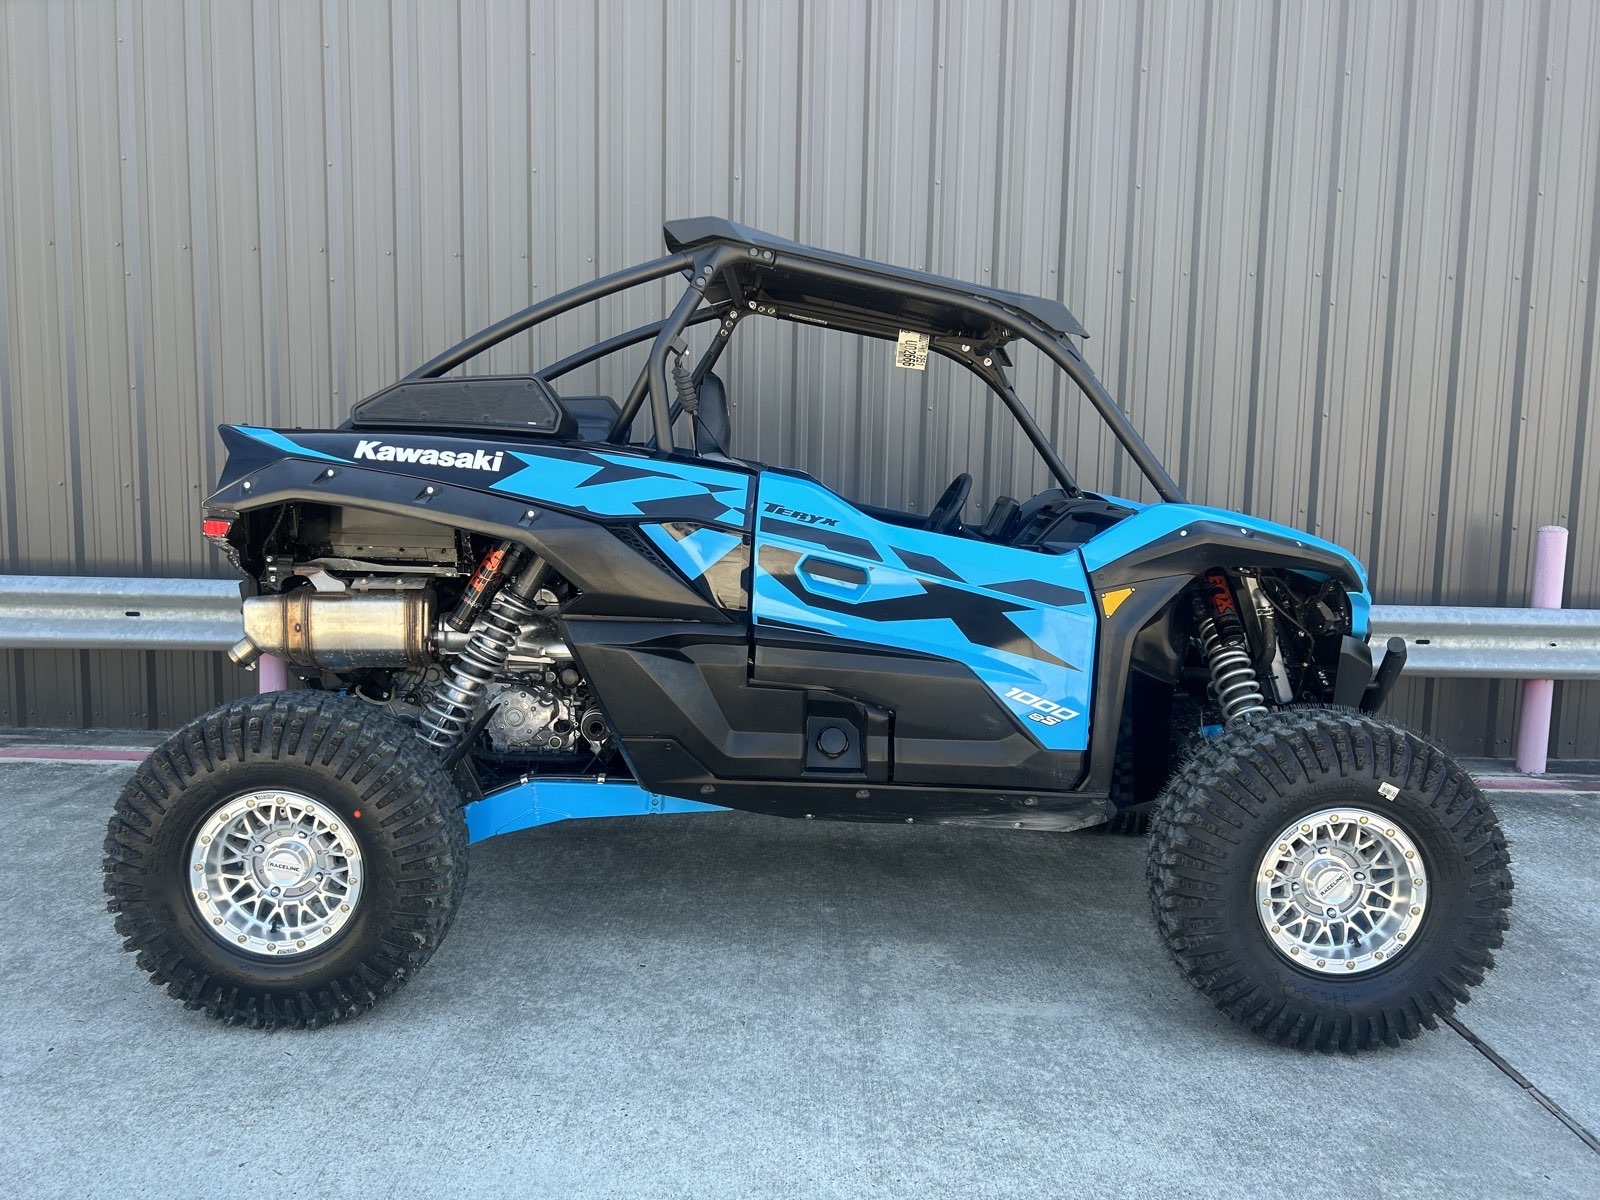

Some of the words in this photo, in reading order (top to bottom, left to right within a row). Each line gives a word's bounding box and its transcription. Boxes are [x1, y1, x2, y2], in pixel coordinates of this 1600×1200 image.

[353, 440, 504, 472] Kawasaki
[763, 501, 840, 527] TERYX
[1003, 687, 1081, 721] 1000
[269, 862, 300, 872] RACELINE
[1320, 874, 1345, 897] RACELINE
